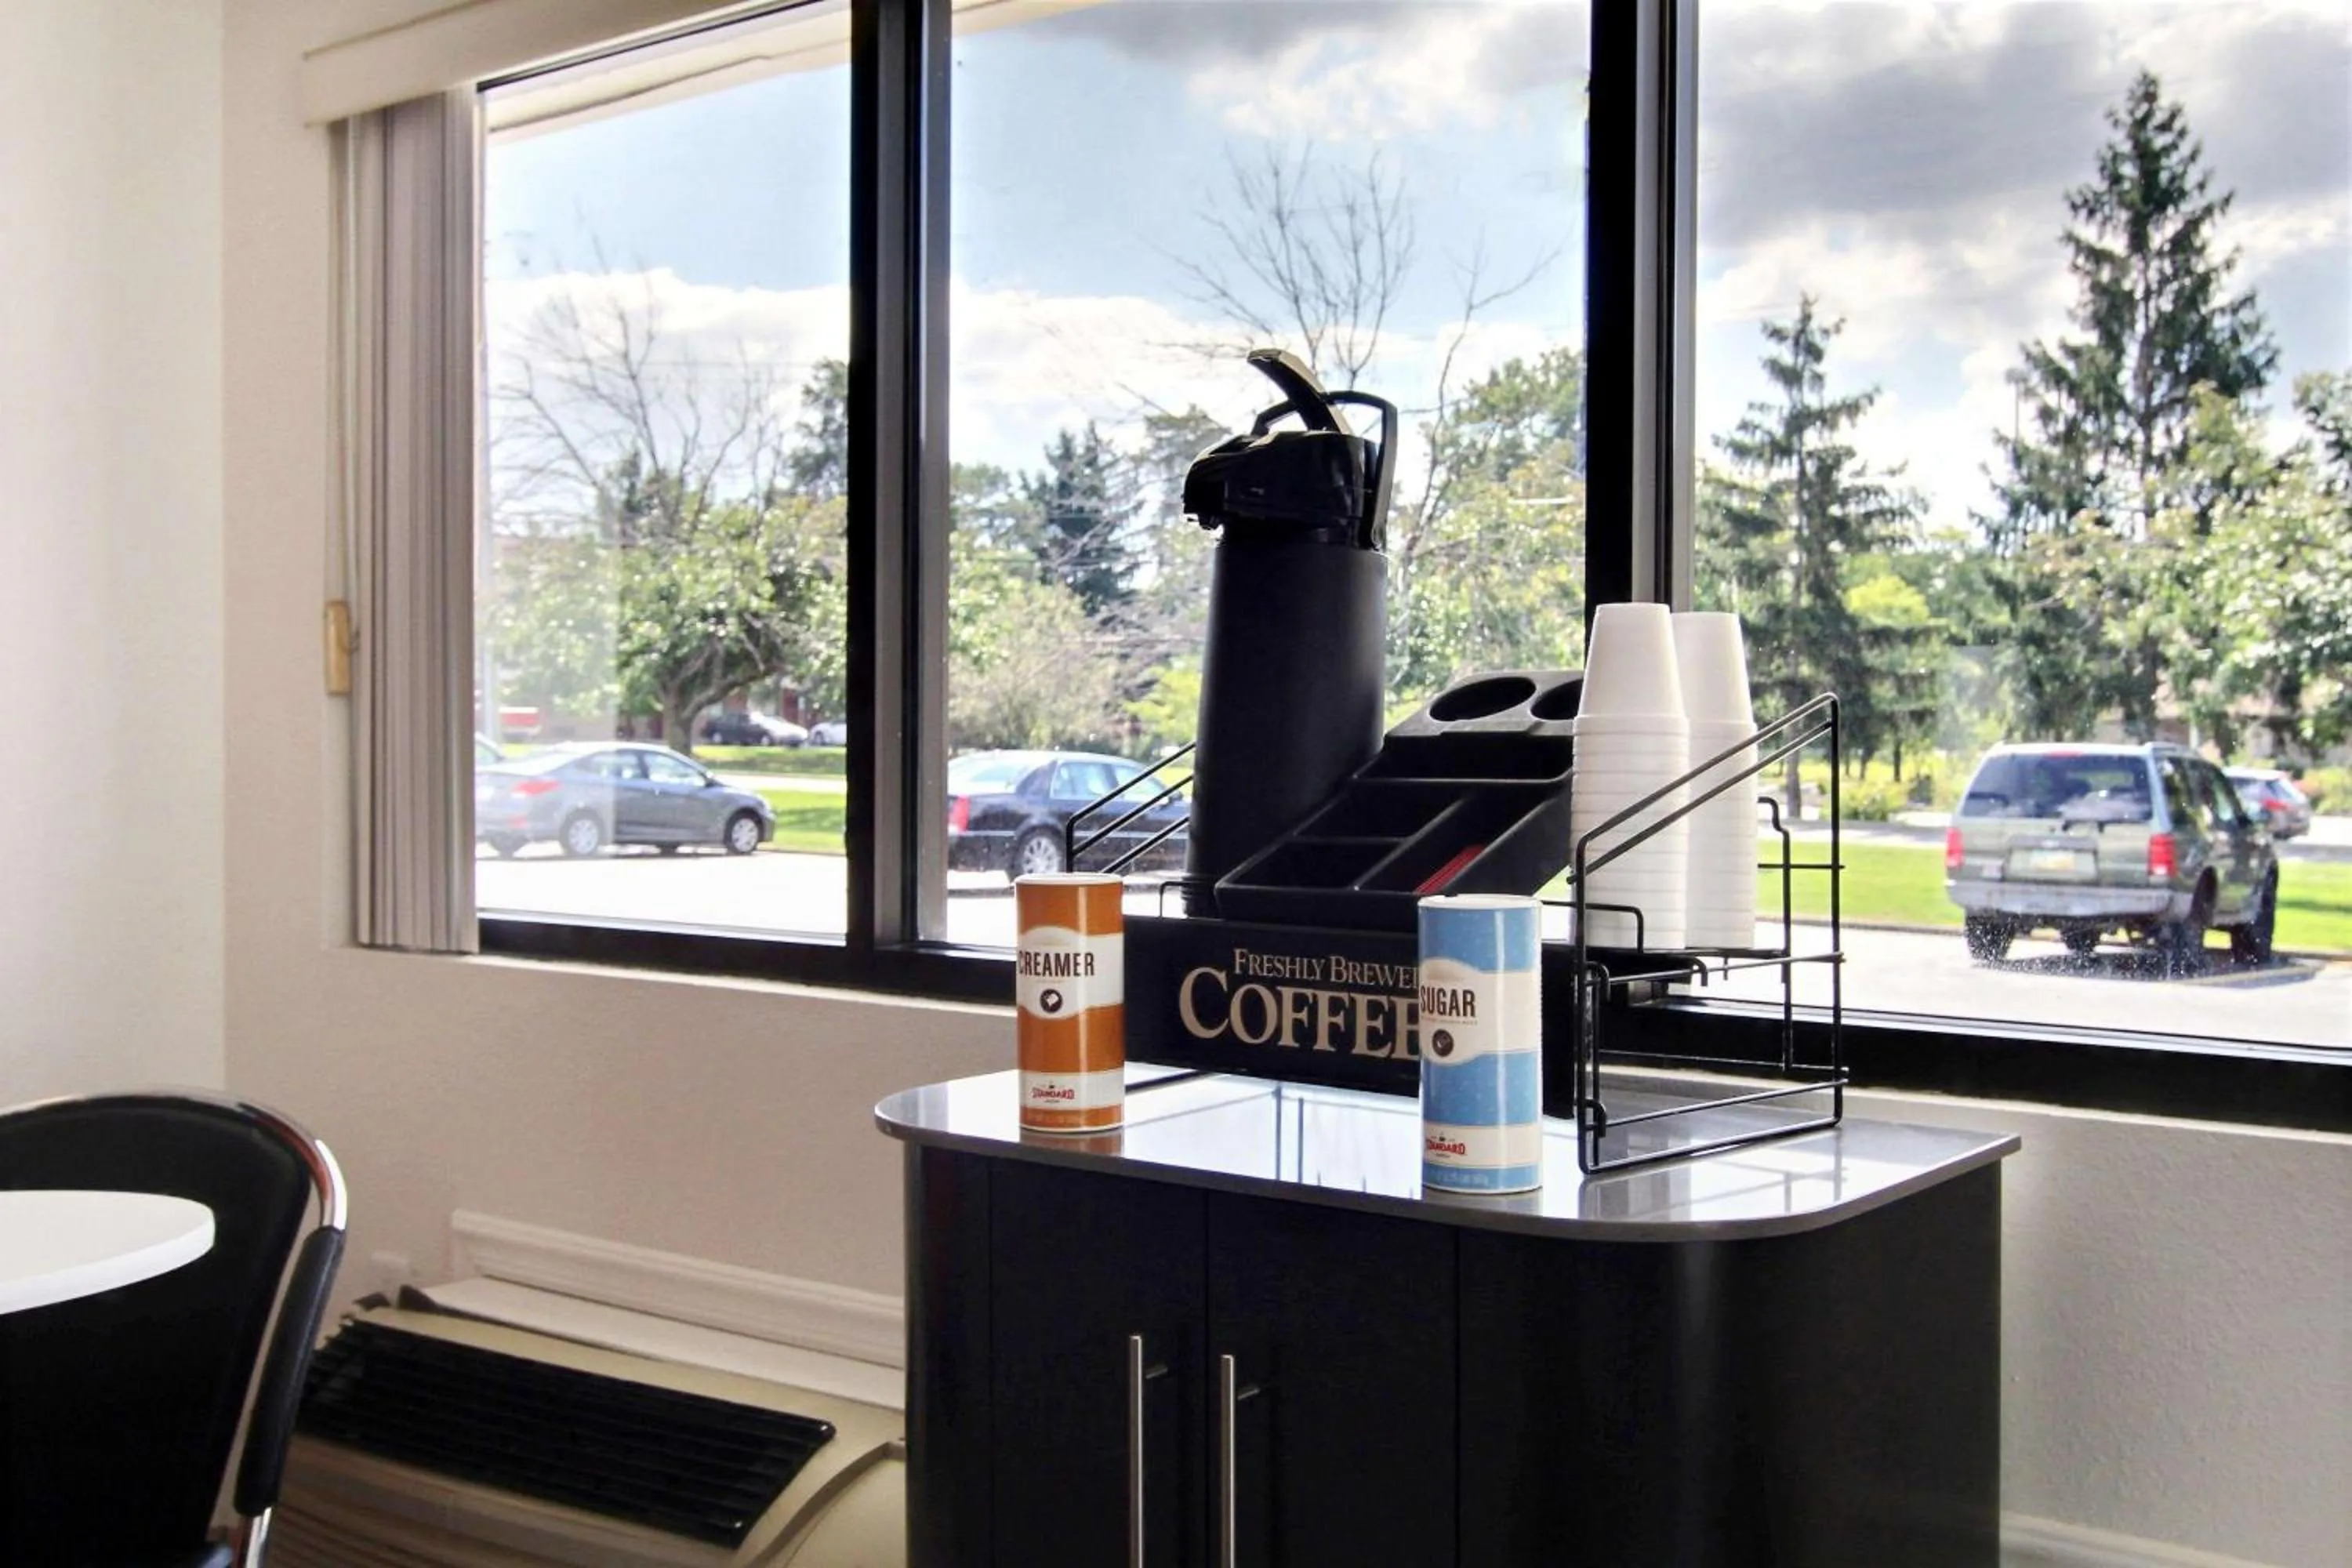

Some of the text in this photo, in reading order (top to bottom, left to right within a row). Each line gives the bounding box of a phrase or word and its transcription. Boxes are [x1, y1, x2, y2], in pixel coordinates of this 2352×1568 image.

[1018, 950, 1094, 978] CREAMER
[1233, 947, 1418, 989] FRESHLY BREWE
[1178, 967, 1418, 1061] COFFEE
[1420, 984, 1476, 1017] SUGAR
